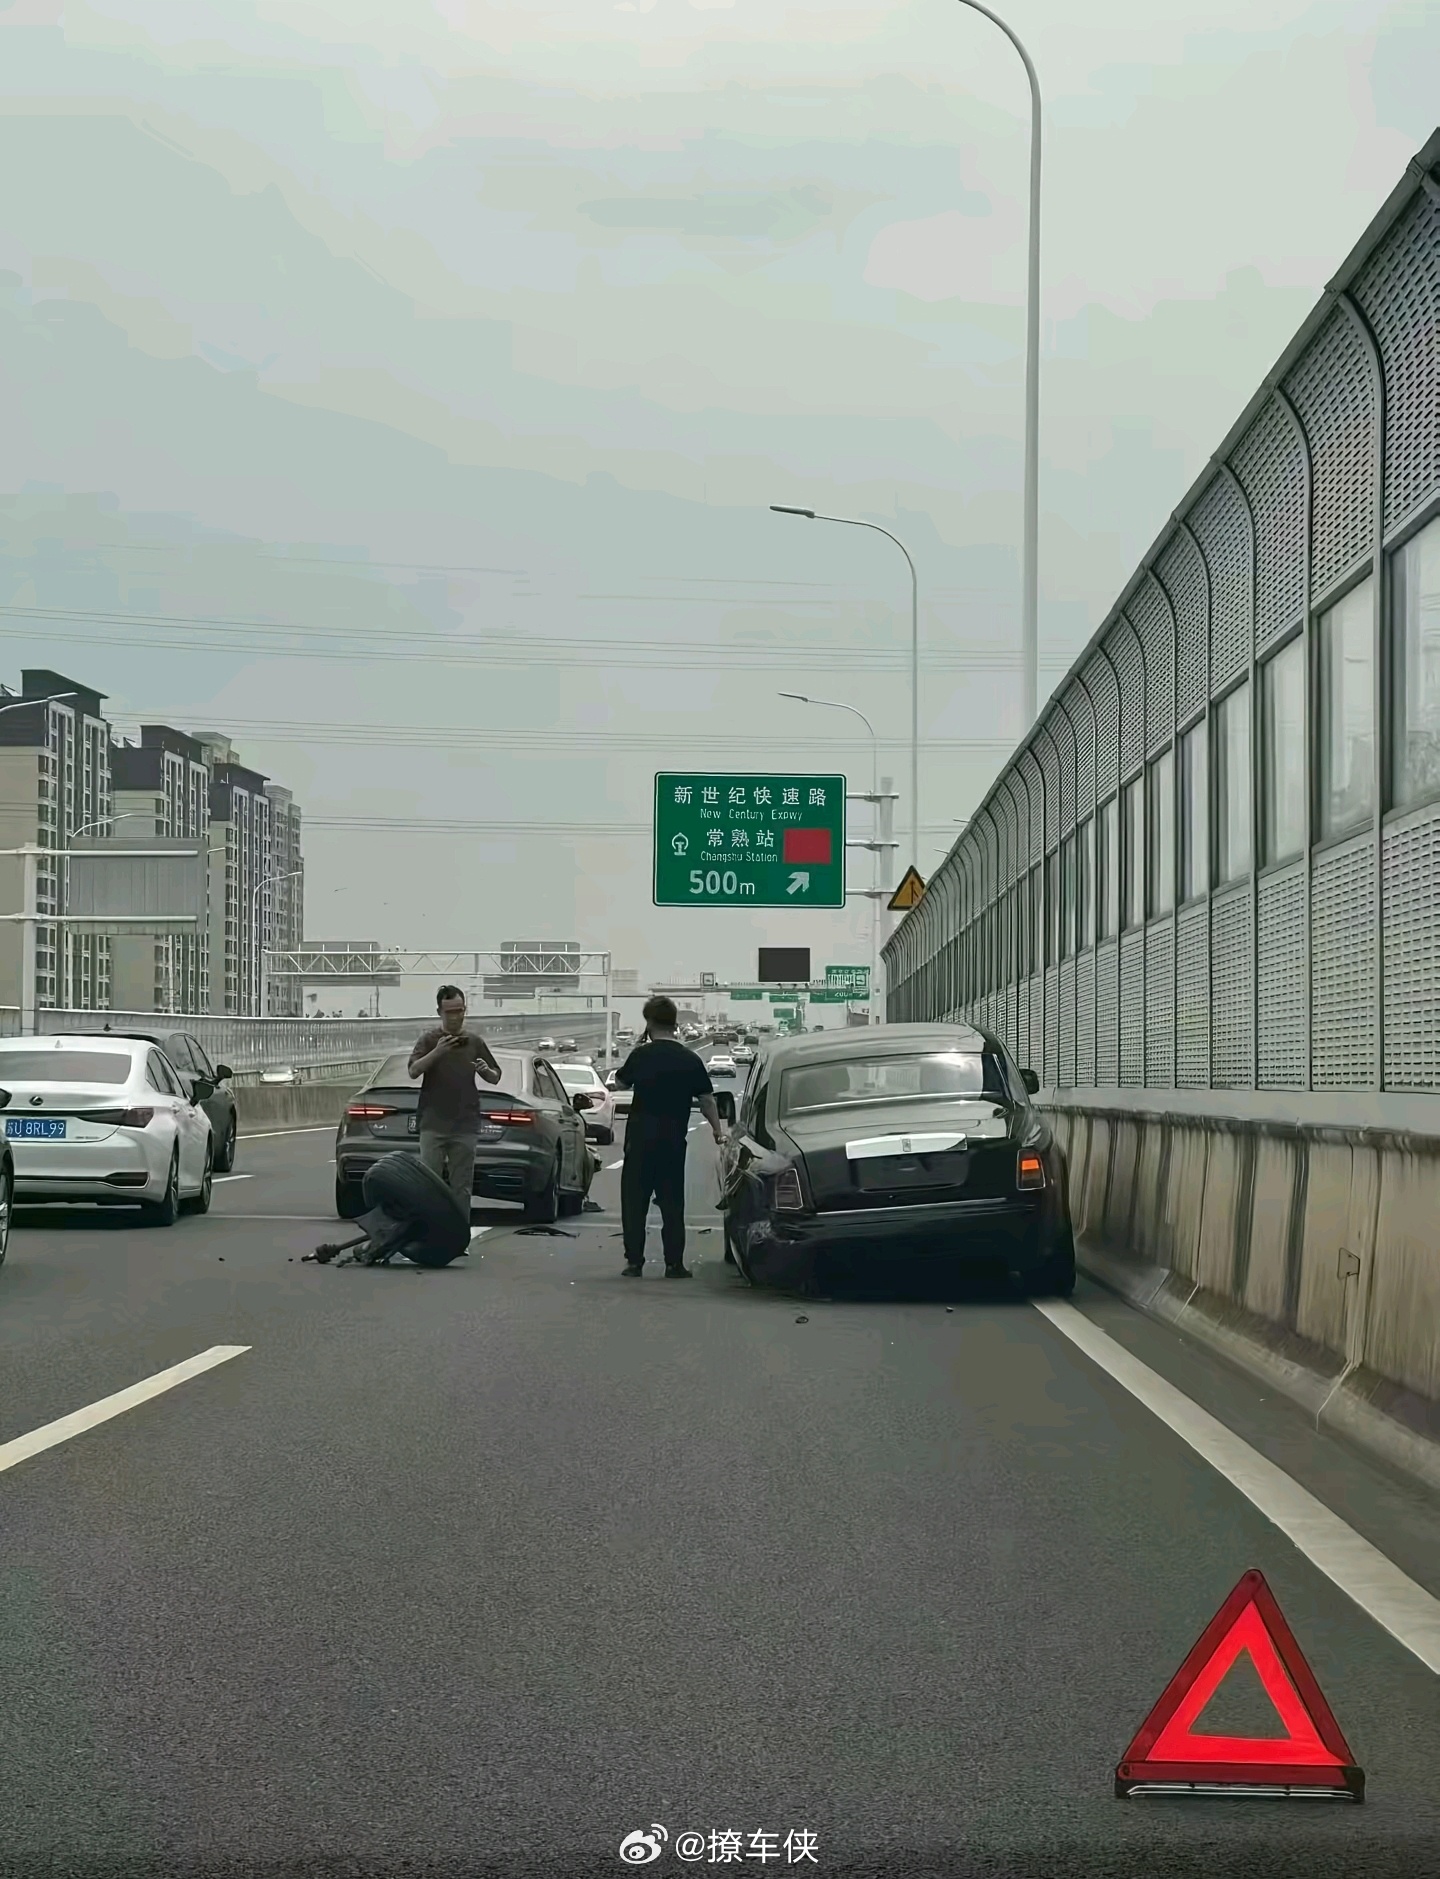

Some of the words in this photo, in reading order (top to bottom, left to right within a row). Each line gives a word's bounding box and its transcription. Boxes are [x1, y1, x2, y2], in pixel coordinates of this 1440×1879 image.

[674, 786, 827, 806] 新世纪快速路
[728, 808, 764, 821] Century
[706, 828, 774, 847] 常熟站
[700, 850, 743, 862] Changshu
[745, 851, 778, 862] Station
[689, 870, 755, 894] 500m
